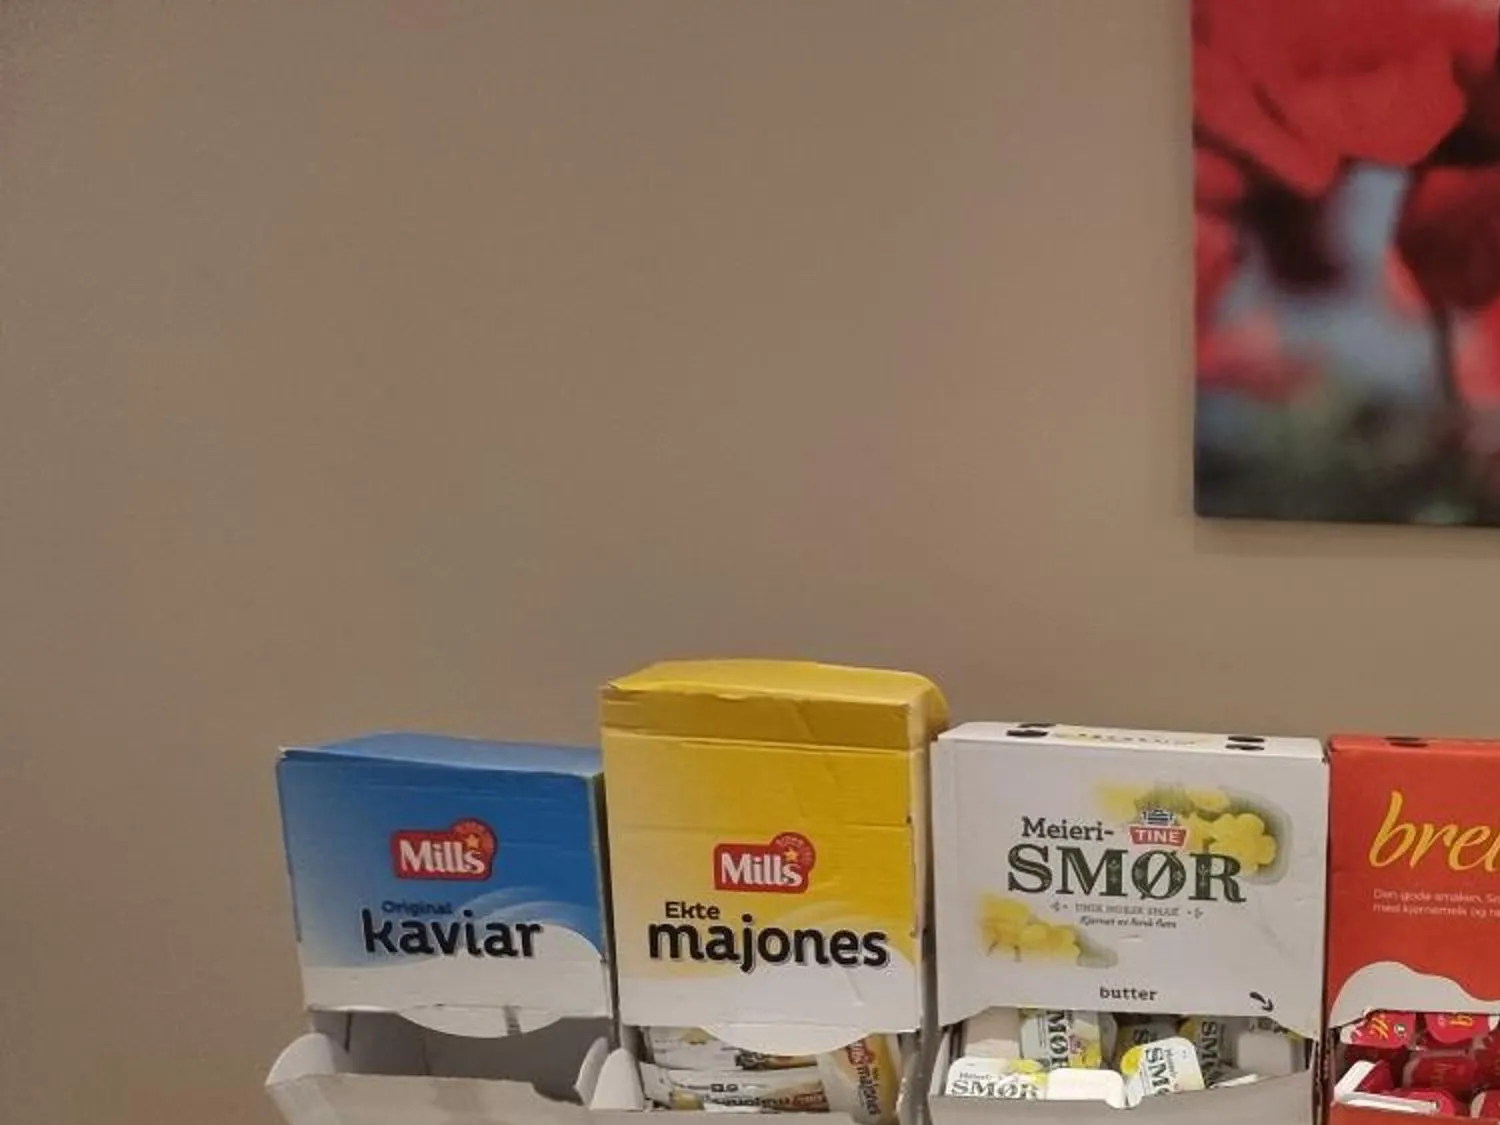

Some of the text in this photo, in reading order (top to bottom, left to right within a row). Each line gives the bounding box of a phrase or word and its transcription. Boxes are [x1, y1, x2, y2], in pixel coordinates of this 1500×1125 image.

[1021, 816, 1115, 841] Meieri-
[1135, 828, 1180, 844] TINE
[400, 839, 486, 875] Mills
[721, 852, 802, 886] Mills
[1007, 843, 1247, 903] SMØR
[381, 900, 454, 915] Original
[664, 901, 721, 920] Ekte
[361, 908, 544, 957] kaviar
[648, 913, 891, 973] majones
[1099, 986, 1158, 1001] butter
